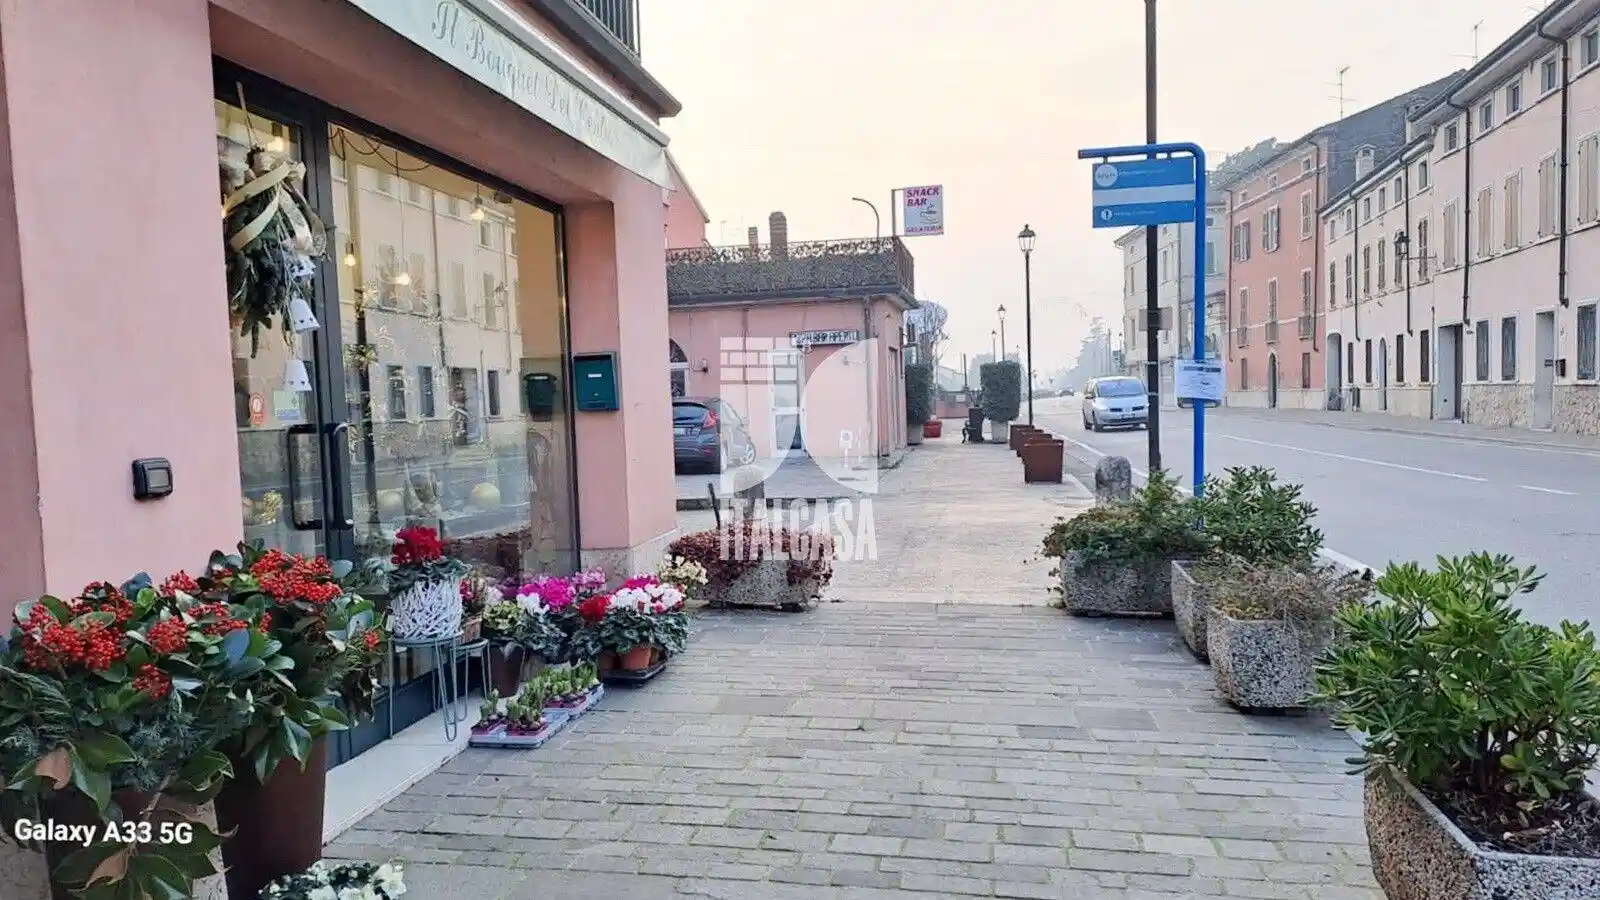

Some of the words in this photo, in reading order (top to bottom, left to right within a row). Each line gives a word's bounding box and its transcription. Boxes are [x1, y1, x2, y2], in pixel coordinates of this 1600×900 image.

[432, 2, 459, 48] Il
[466, 17, 540, 101] Bouquet
[906, 187, 939, 197] SNACK
[907, 197, 928, 207] BAR
[906, 225, 943, 233] GELATERIA
